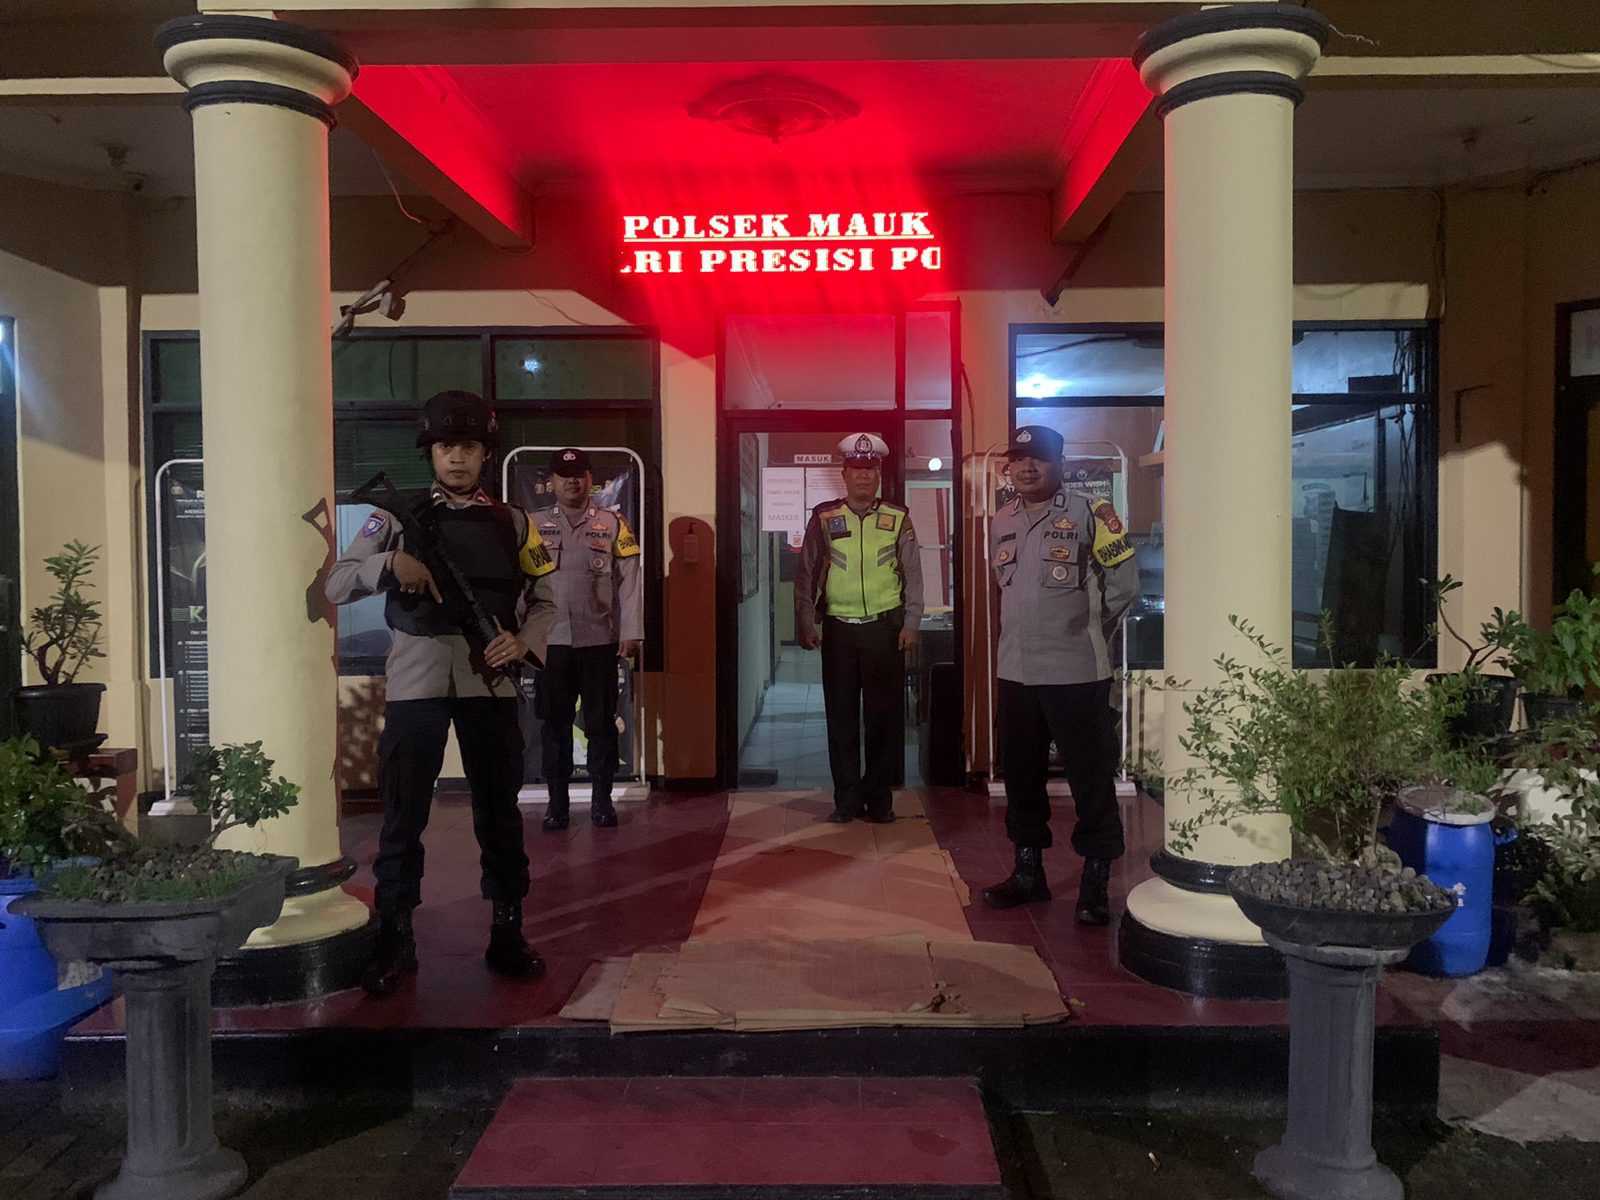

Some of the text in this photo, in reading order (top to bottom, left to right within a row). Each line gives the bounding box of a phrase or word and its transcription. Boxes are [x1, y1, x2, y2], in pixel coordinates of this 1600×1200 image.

[623, 211, 931, 238] POLSEK MAUK
[700, 247, 875, 273] PRESISI
[796, 455, 831, 463] MASUK
[585, 531, 610, 539] POLRI
[1043, 531, 1079, 541] POLRI
